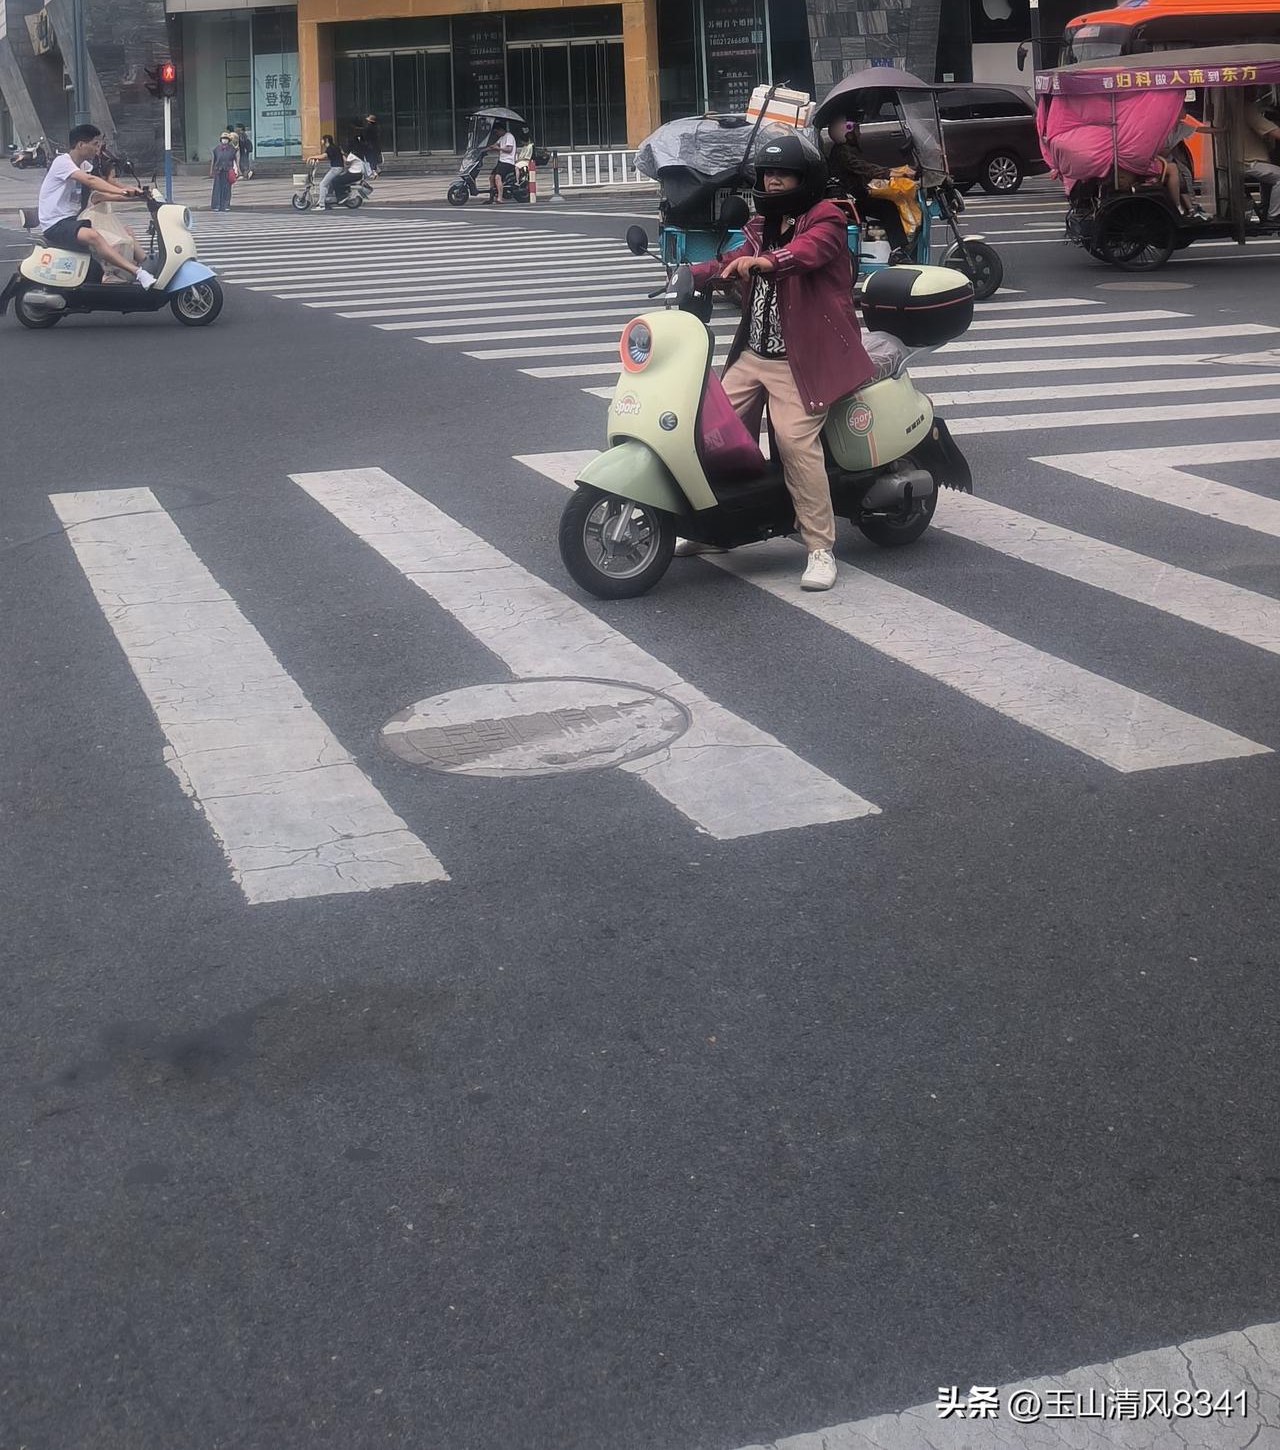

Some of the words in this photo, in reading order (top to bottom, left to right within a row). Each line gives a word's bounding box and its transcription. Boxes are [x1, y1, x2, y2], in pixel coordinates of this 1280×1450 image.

[1102, 65, 1257, 89] 看妇科做人流到东方
[265, 91, 292, 107] 登场
